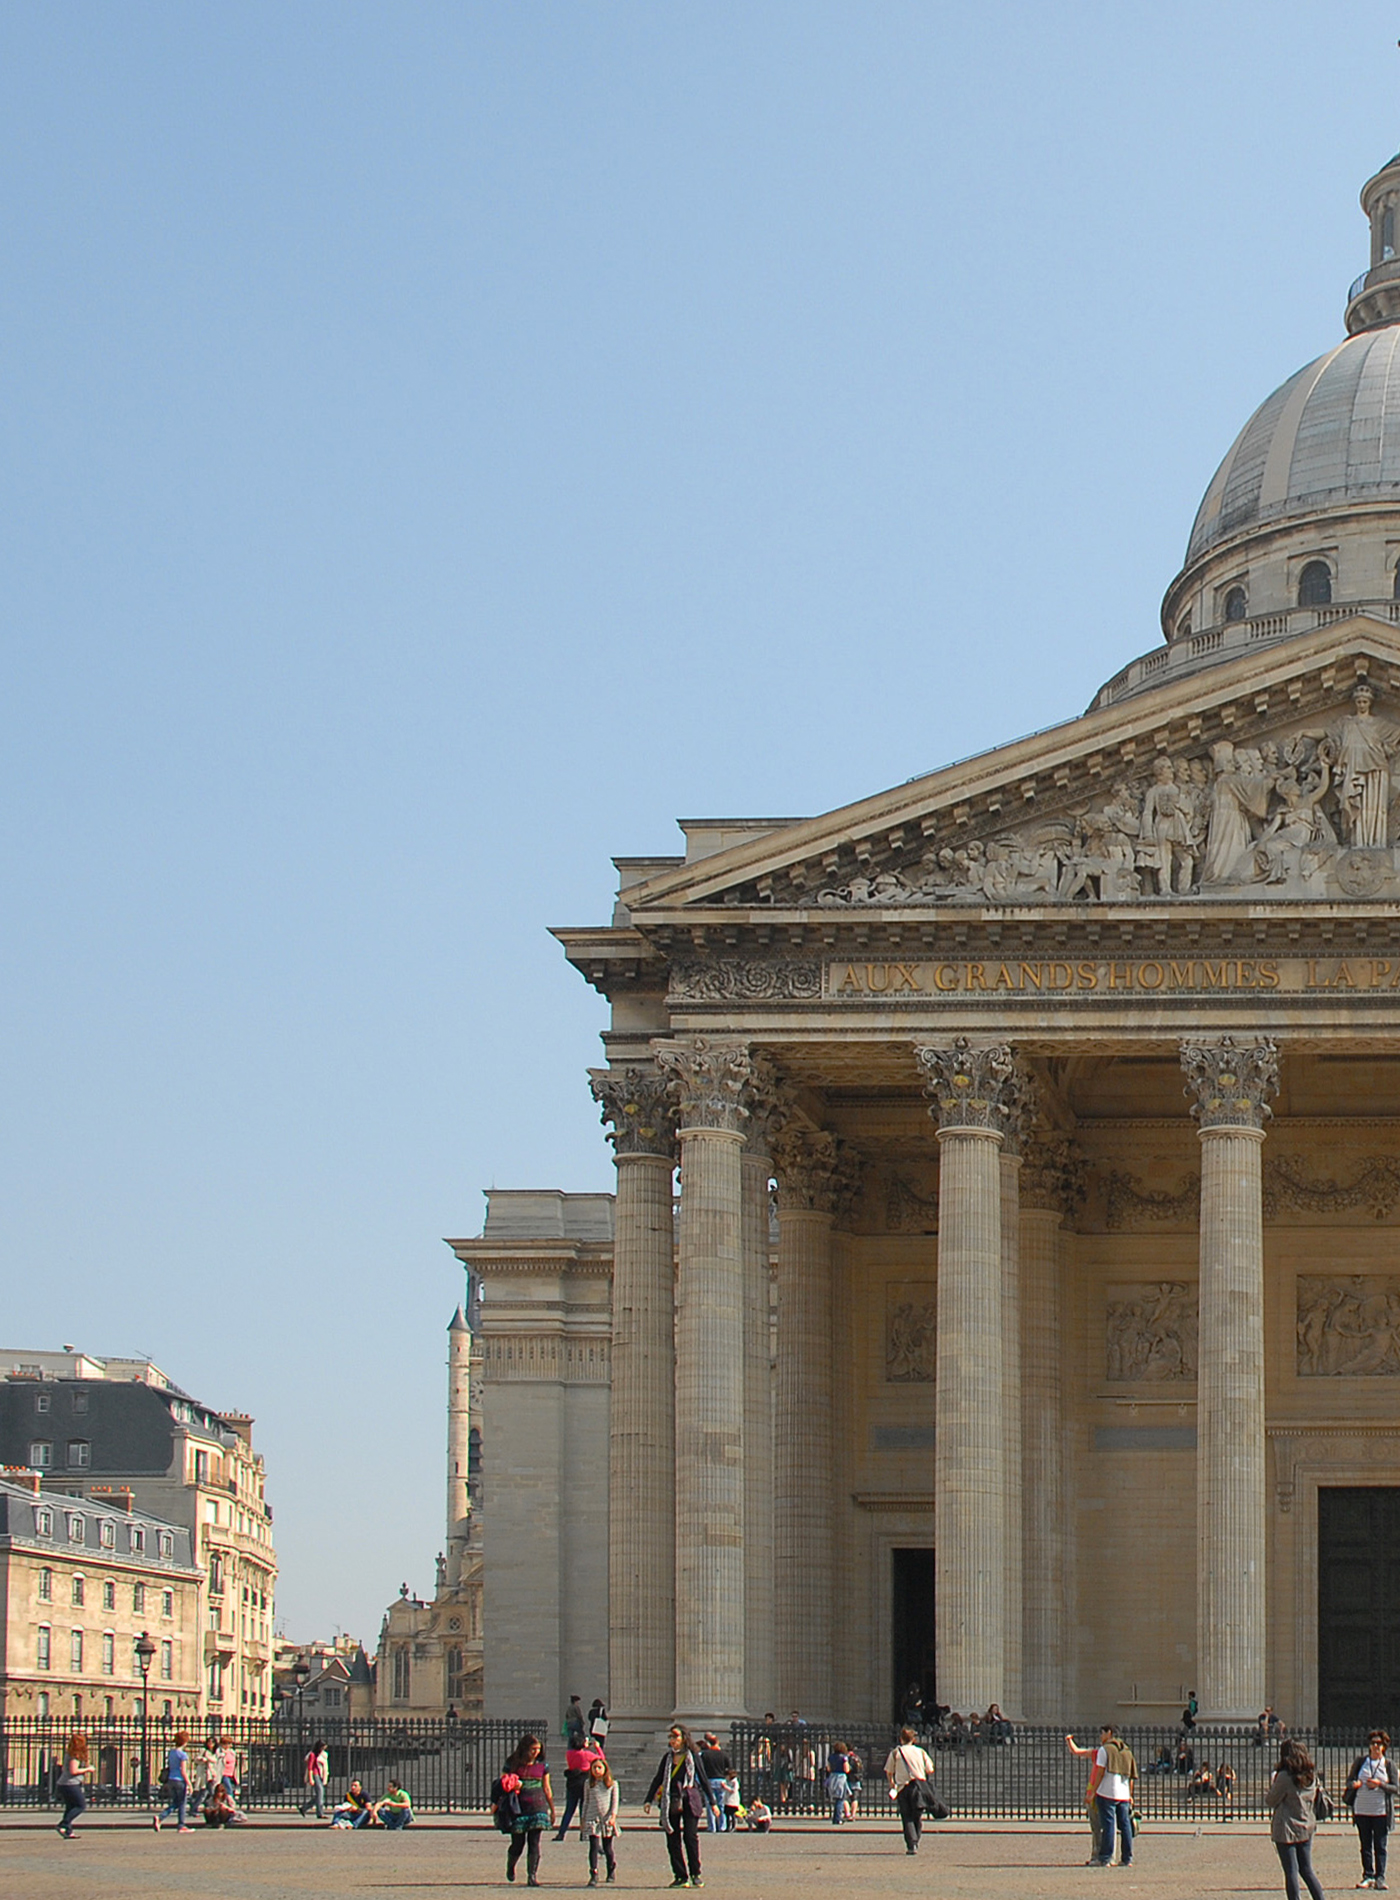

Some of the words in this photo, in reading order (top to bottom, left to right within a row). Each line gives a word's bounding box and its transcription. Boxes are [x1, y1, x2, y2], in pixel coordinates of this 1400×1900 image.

[837, 963, 922, 992] AUX
[933, 961, 1098, 992] GRANDS
[1106, 960, 1280, 990] HOMMES
[1304, 959, 1355, 987] LA
